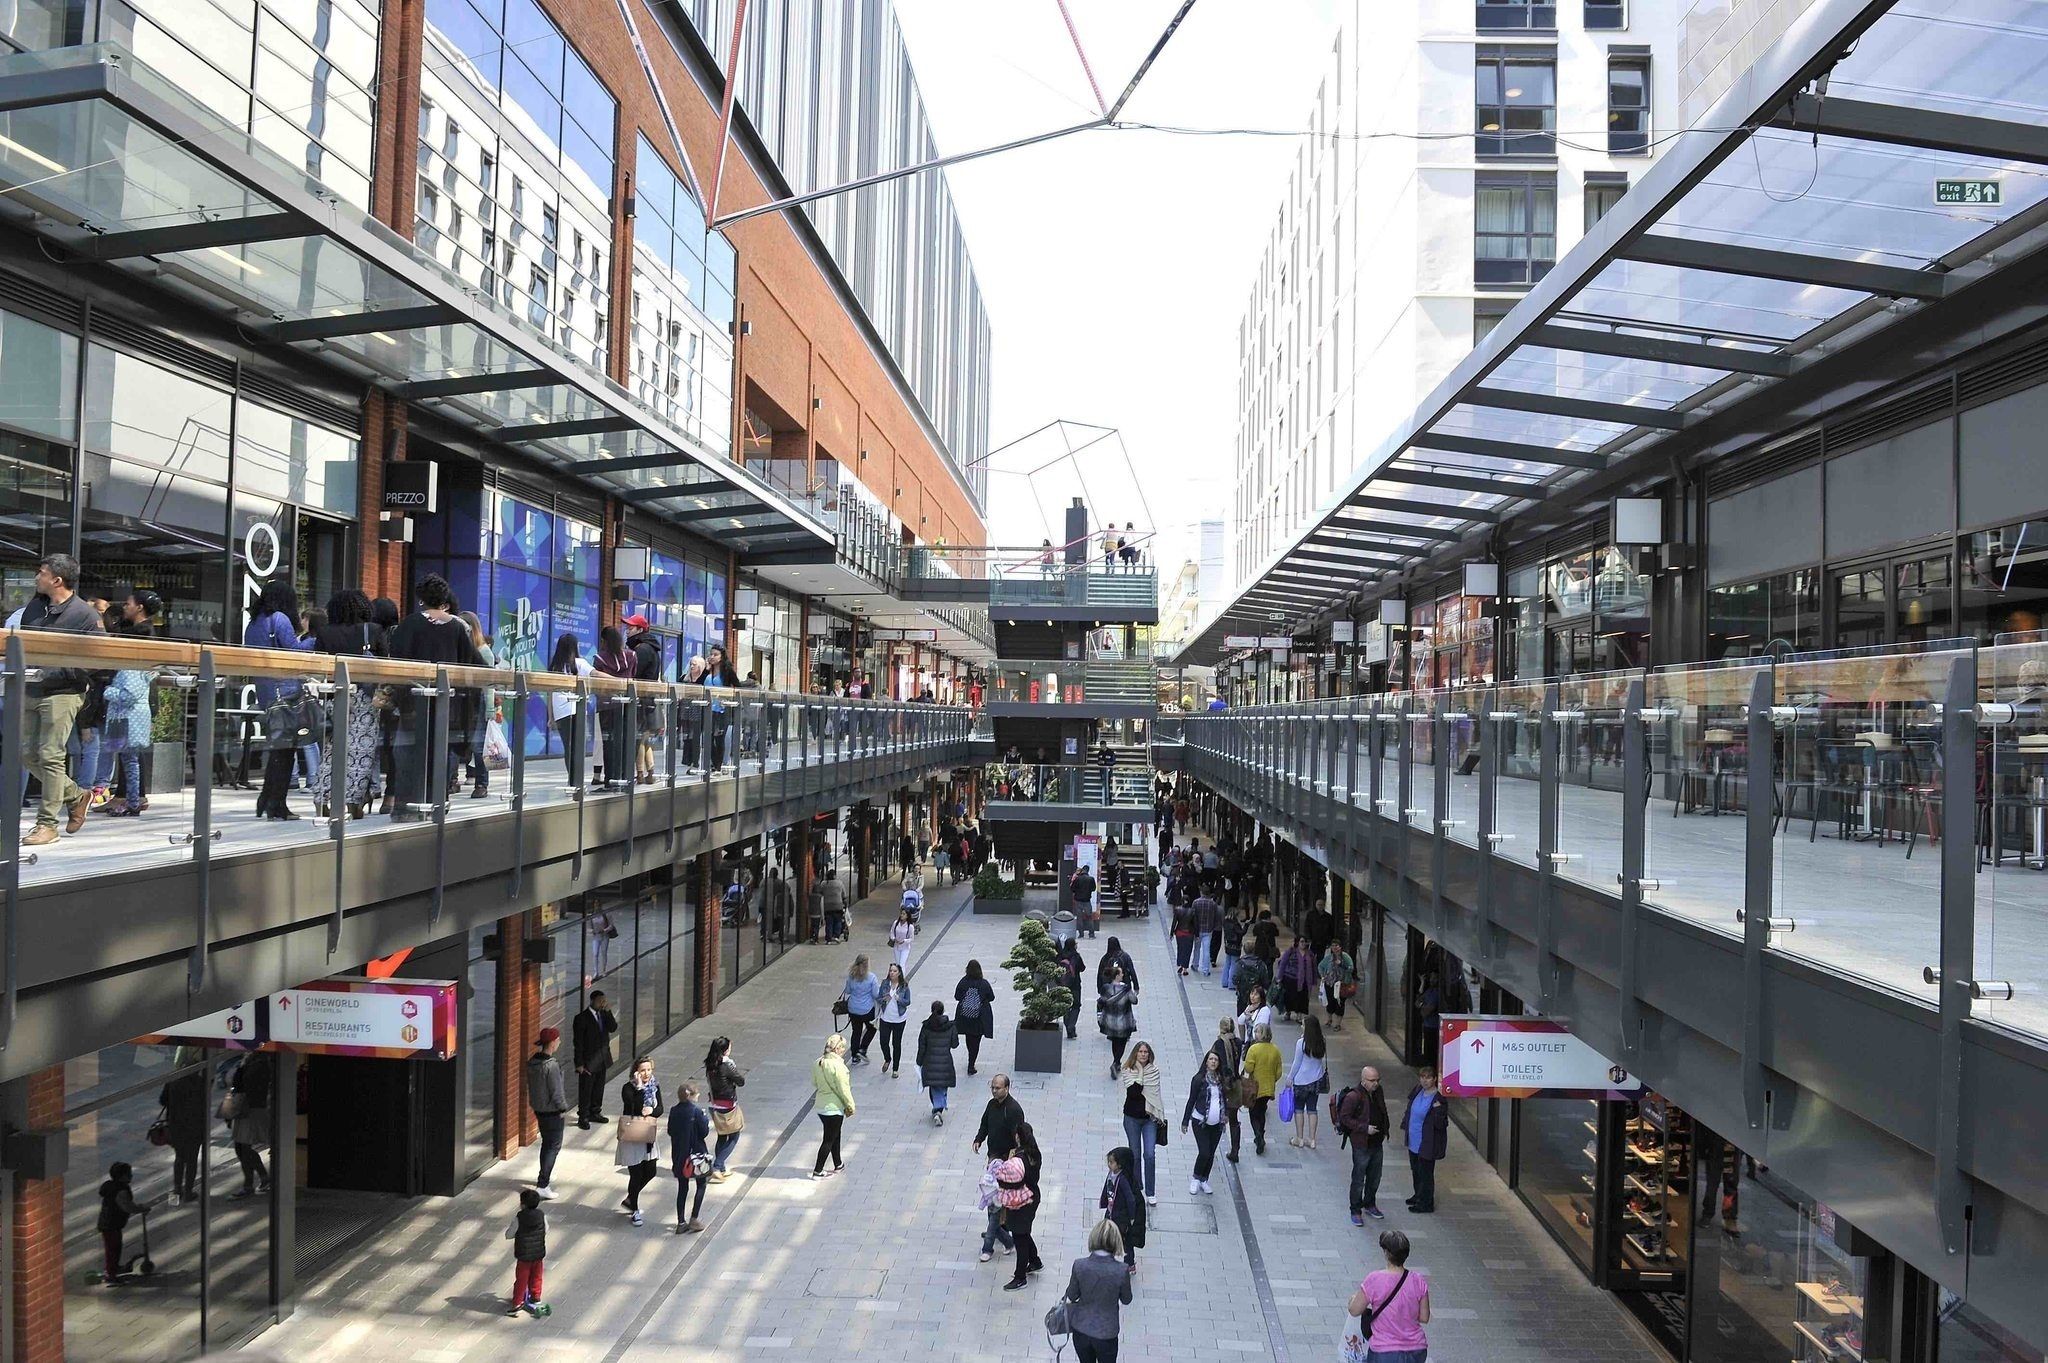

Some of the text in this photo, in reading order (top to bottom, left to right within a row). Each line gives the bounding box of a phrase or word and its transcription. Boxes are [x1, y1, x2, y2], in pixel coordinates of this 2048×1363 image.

[386, 492, 425, 504] PREZZO
[516, 596, 547, 641] Pay
[528, 637, 536, 649] TO
[305, 997, 360, 1009] CINEWORLD
[305, 1021, 371, 1033] RESTAURANTS
[1502, 1043, 1567, 1053] M&S OUTLET
[1502, 1064, 1543, 1074] TOILETS
